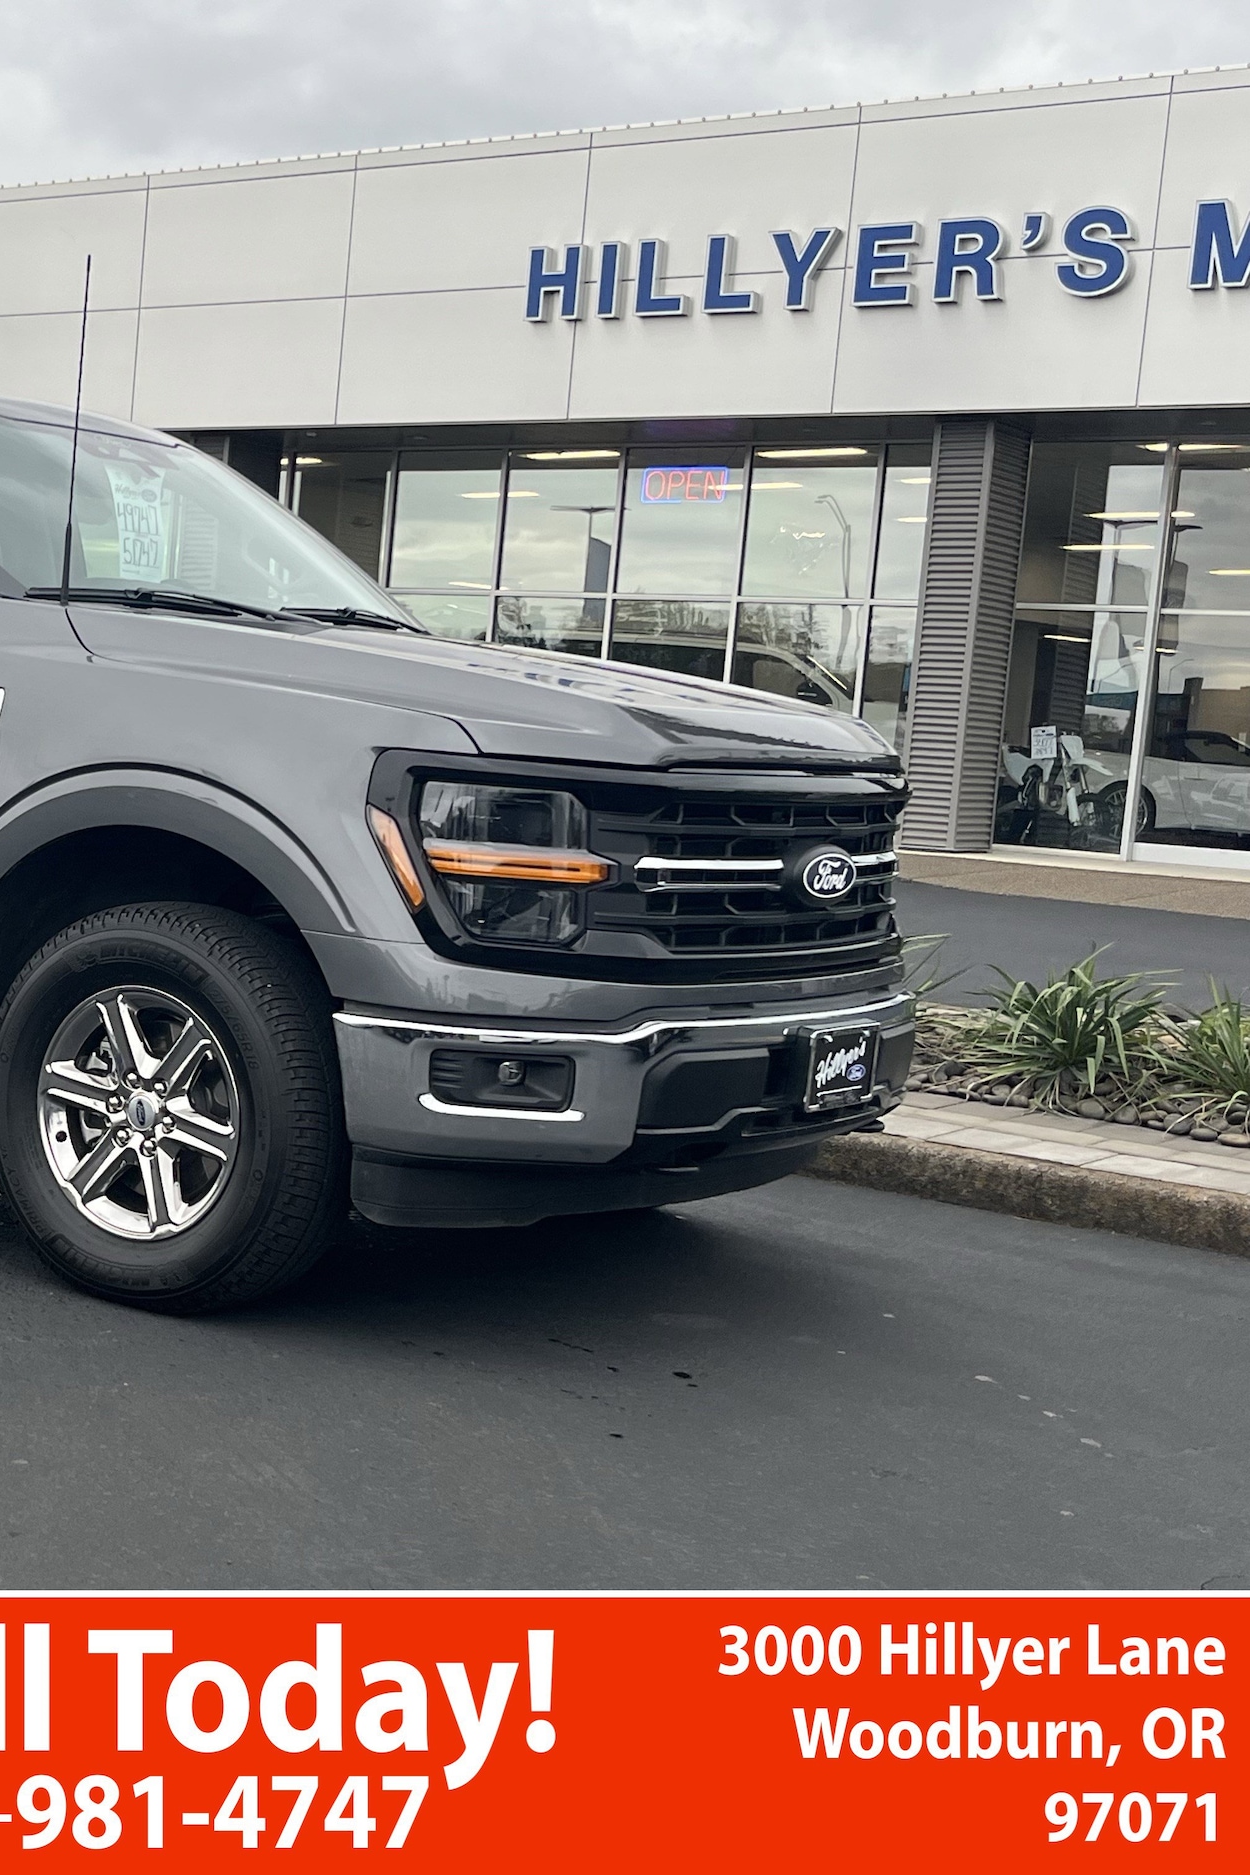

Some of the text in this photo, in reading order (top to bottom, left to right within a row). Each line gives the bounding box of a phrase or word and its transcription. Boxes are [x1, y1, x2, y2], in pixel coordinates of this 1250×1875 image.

[525, 206, 1138, 322] HILLYER'S
[645, 470, 725, 500] OPEN
[813, 859, 848, 890] Ford
